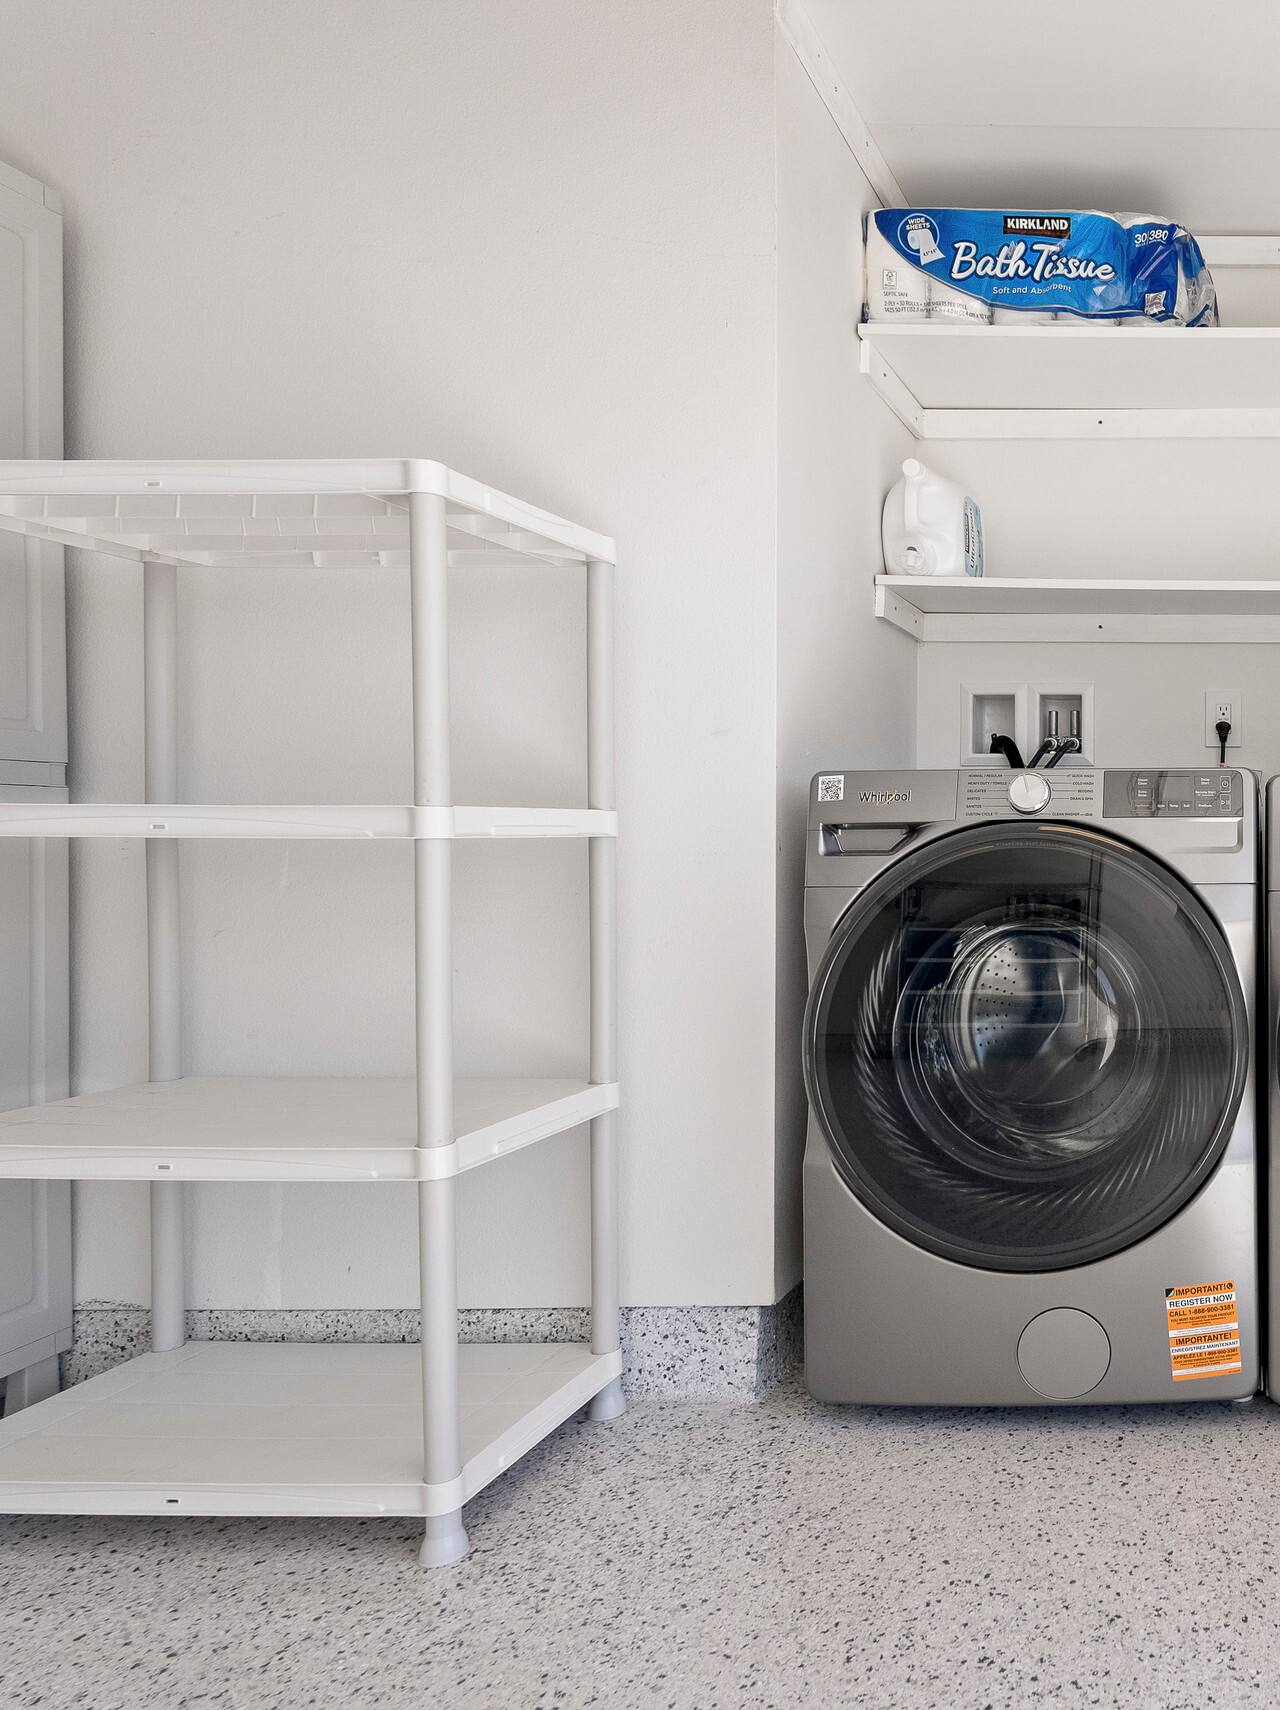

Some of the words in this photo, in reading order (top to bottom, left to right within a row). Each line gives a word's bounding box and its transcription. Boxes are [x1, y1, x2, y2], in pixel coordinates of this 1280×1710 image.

[908, 217, 925, 225] WIDE
[1007, 218, 1069, 230] KIRKLAND
[1135, 233, 1147, 244] 30
[1149, 230, 1169, 241] 380
[951, 241, 1032, 280] Bath
[1033, 243, 1116, 281] Tissue
[993, 286, 1010, 294] Soft
[1012, 286, 1028, 294] and
[1030, 283, 1072, 295] Absorbent
[859, 790, 912, 804] Whirlpool
[1175, 1283, 1227, 1297] IMPORTANT!
[1169, 1297, 1211, 1308] REGISTER
[1213, 1294, 1233, 1303] NOW
[1175, 1332, 1232, 1346] IMPORTANTE!
